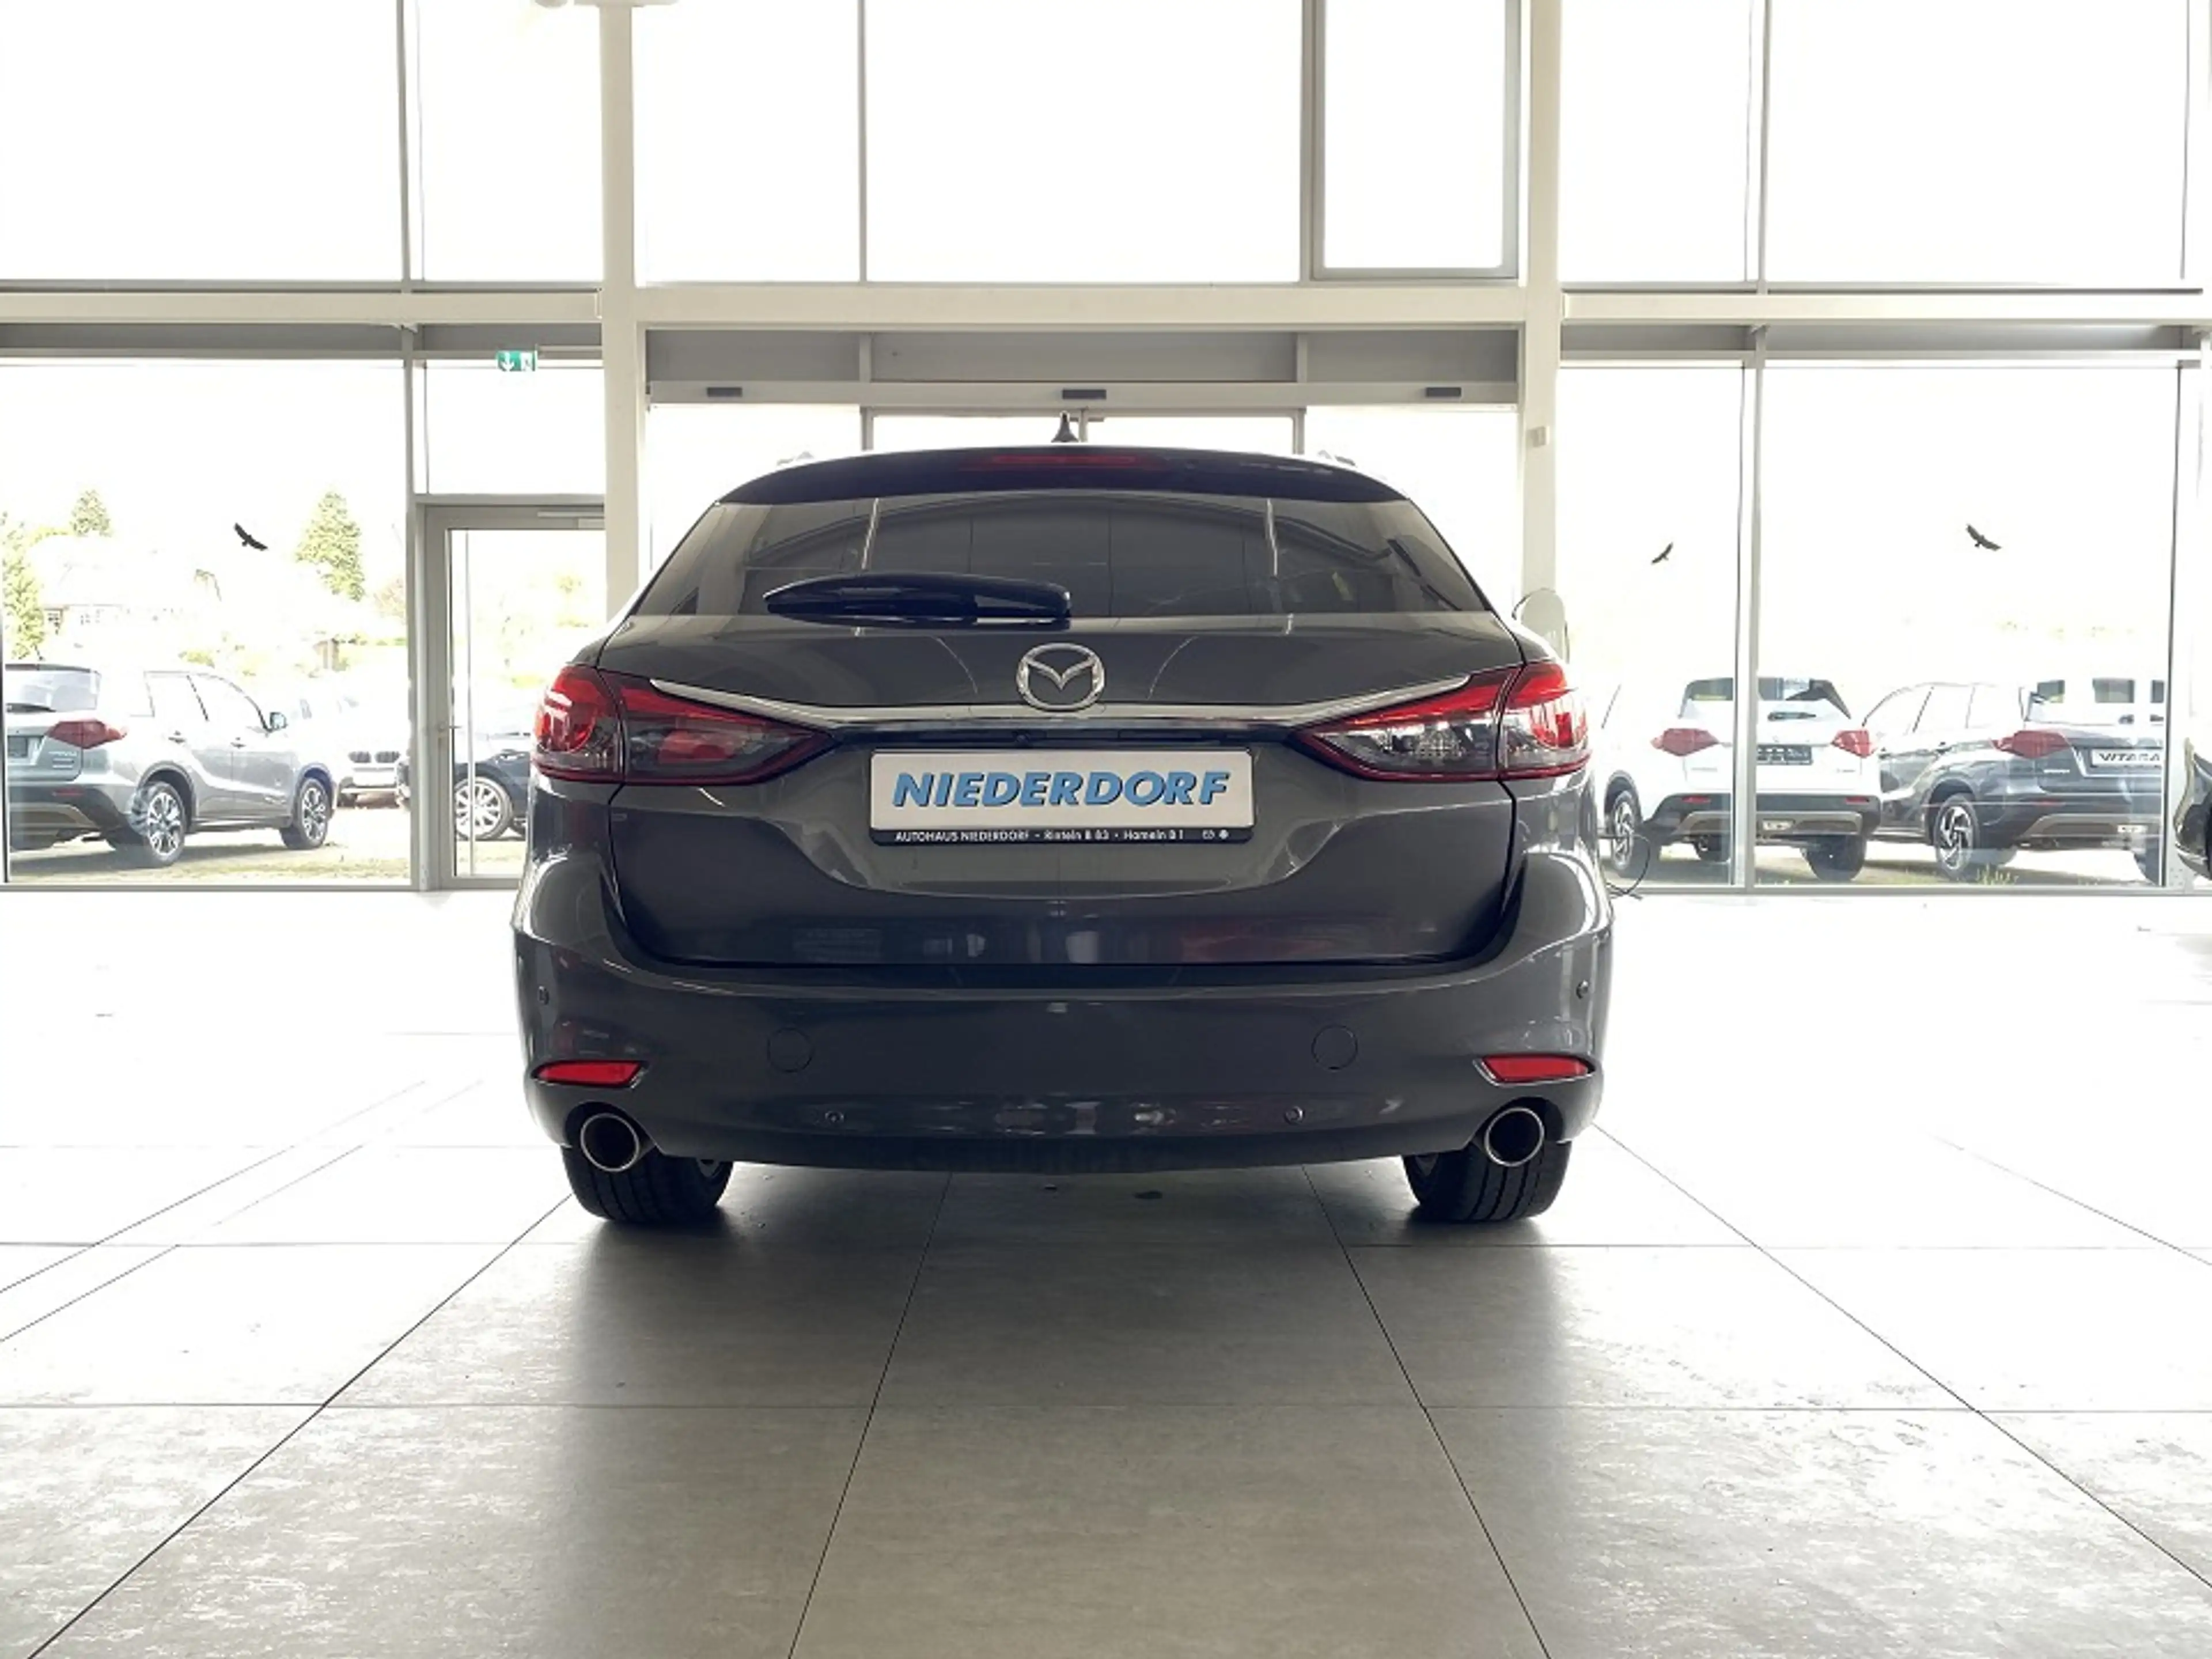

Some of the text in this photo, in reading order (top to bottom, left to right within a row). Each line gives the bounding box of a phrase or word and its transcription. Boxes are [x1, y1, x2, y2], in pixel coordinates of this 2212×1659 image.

[893, 771, 1230, 806] NIEDERDORF
[895, 831, 958, 842] AUTOHAUS
[960, 830, 1029, 841] NIEDERDORF
